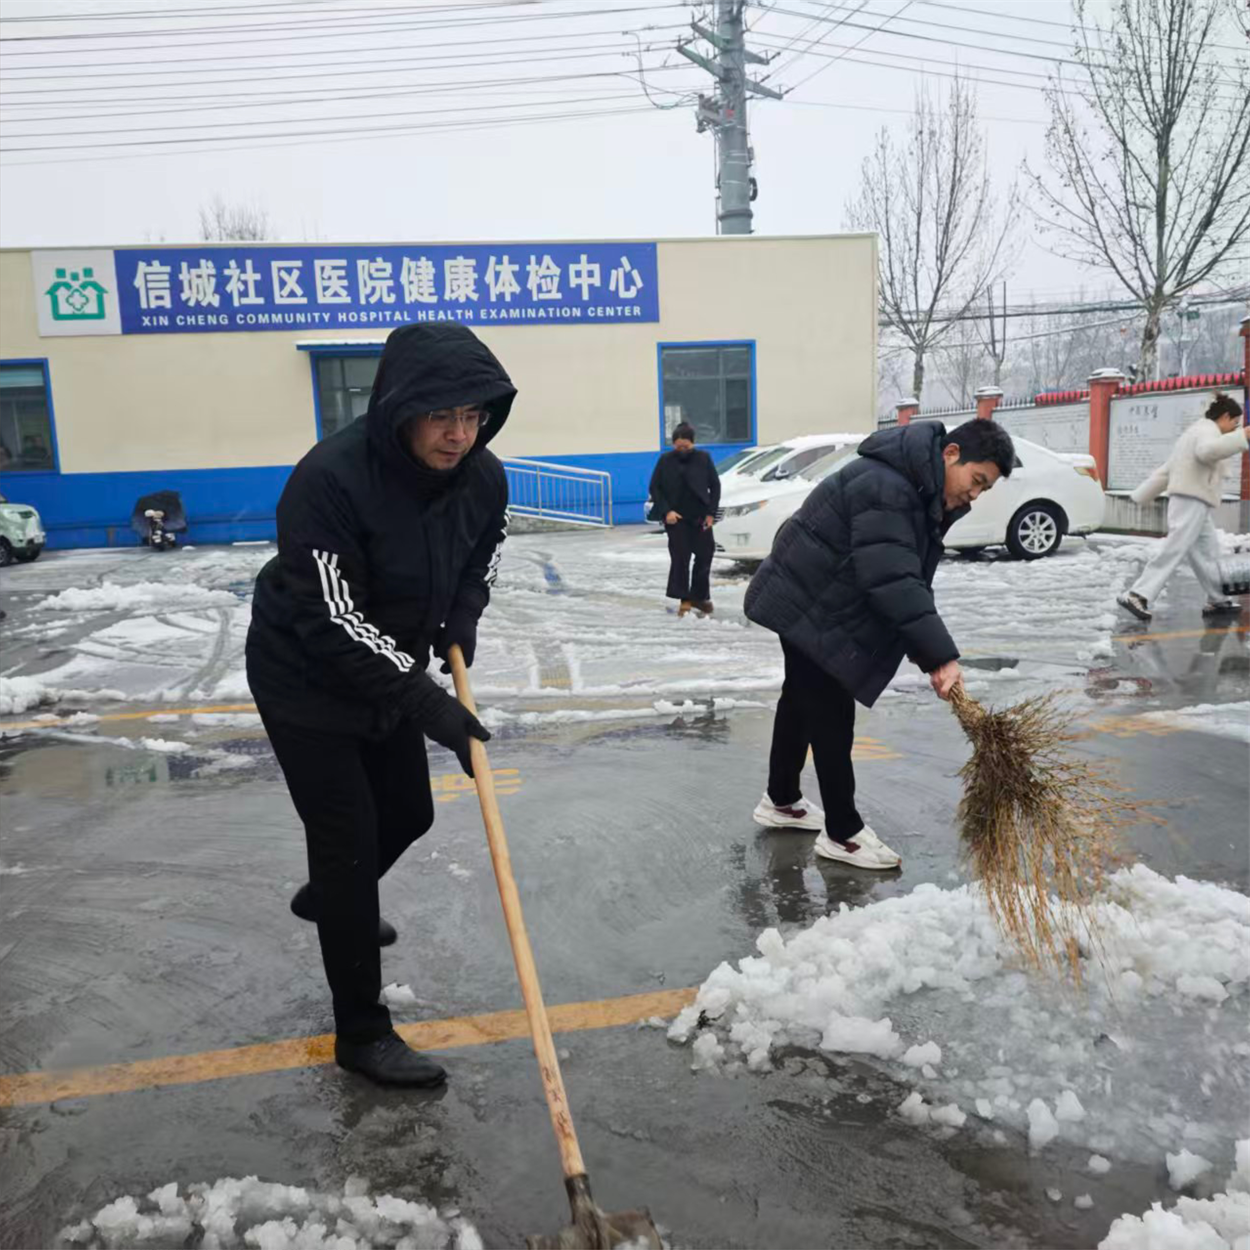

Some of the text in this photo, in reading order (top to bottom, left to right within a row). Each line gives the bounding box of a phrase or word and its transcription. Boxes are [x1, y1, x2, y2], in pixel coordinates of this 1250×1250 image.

[134, 255, 644, 309] 信城社区医院健康体检中心
[142, 306, 641, 326] XIN CHENG COMMUNITY HOSPITAL HEALTH EXAMINATION CENTER
